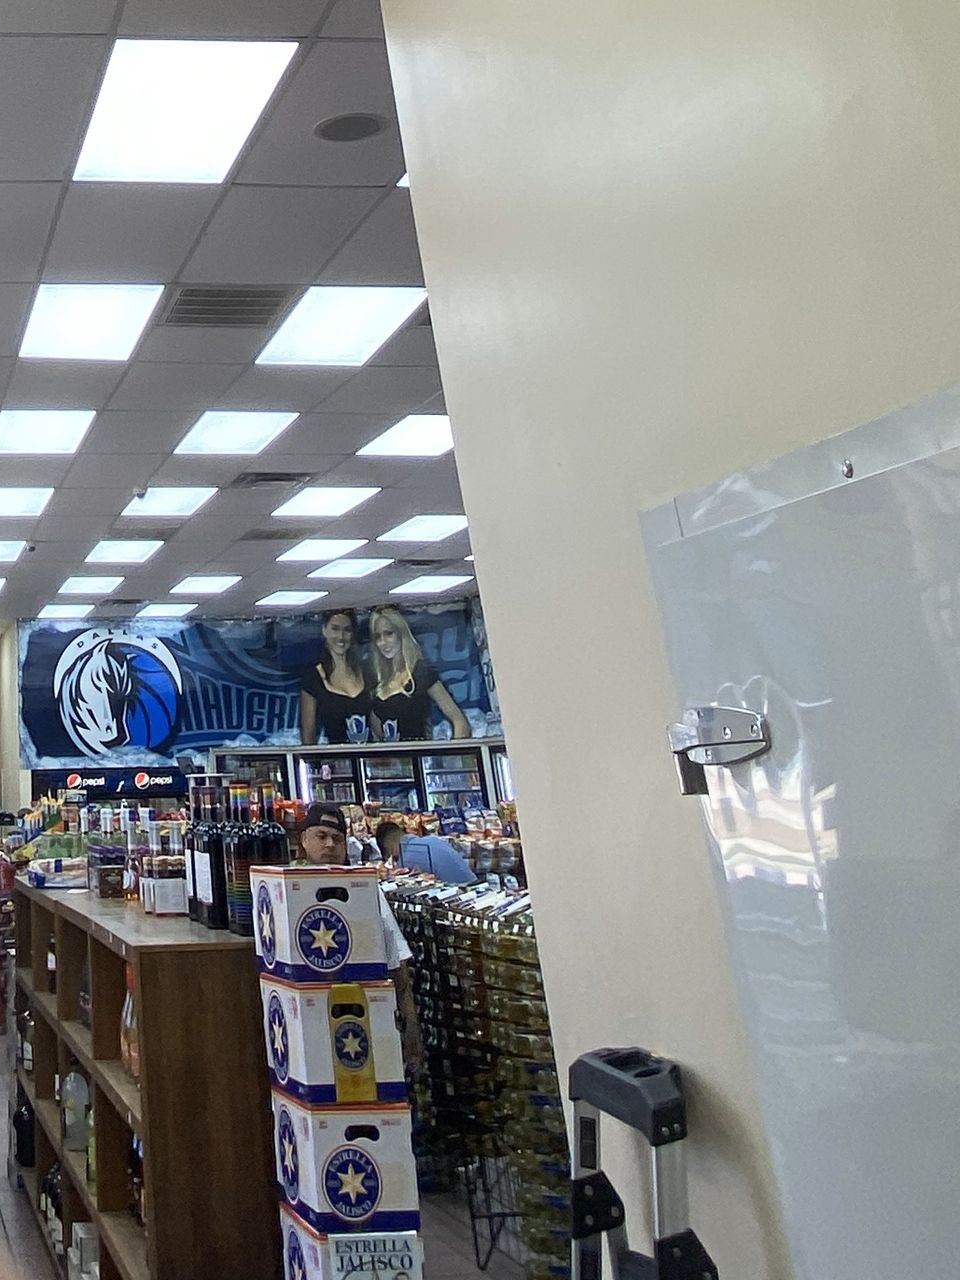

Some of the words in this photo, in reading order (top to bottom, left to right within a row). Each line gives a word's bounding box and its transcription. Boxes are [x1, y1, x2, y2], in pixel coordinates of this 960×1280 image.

[77, 628, 158, 649] DALLAS
[83, 777, 105, 786] pepsi
[150, 776, 172, 785] pepsi
[302, 910, 343, 930] ESTRELLA
[308, 953, 343, 968] JALISCO
[328, 1150, 372, 1173] ESTRELLA
[337, 1200, 372, 1217] JALISCO
[335, 1239, 412, 1254] ESTRELLA
[337, 1254, 413, 1273] JALISCO
